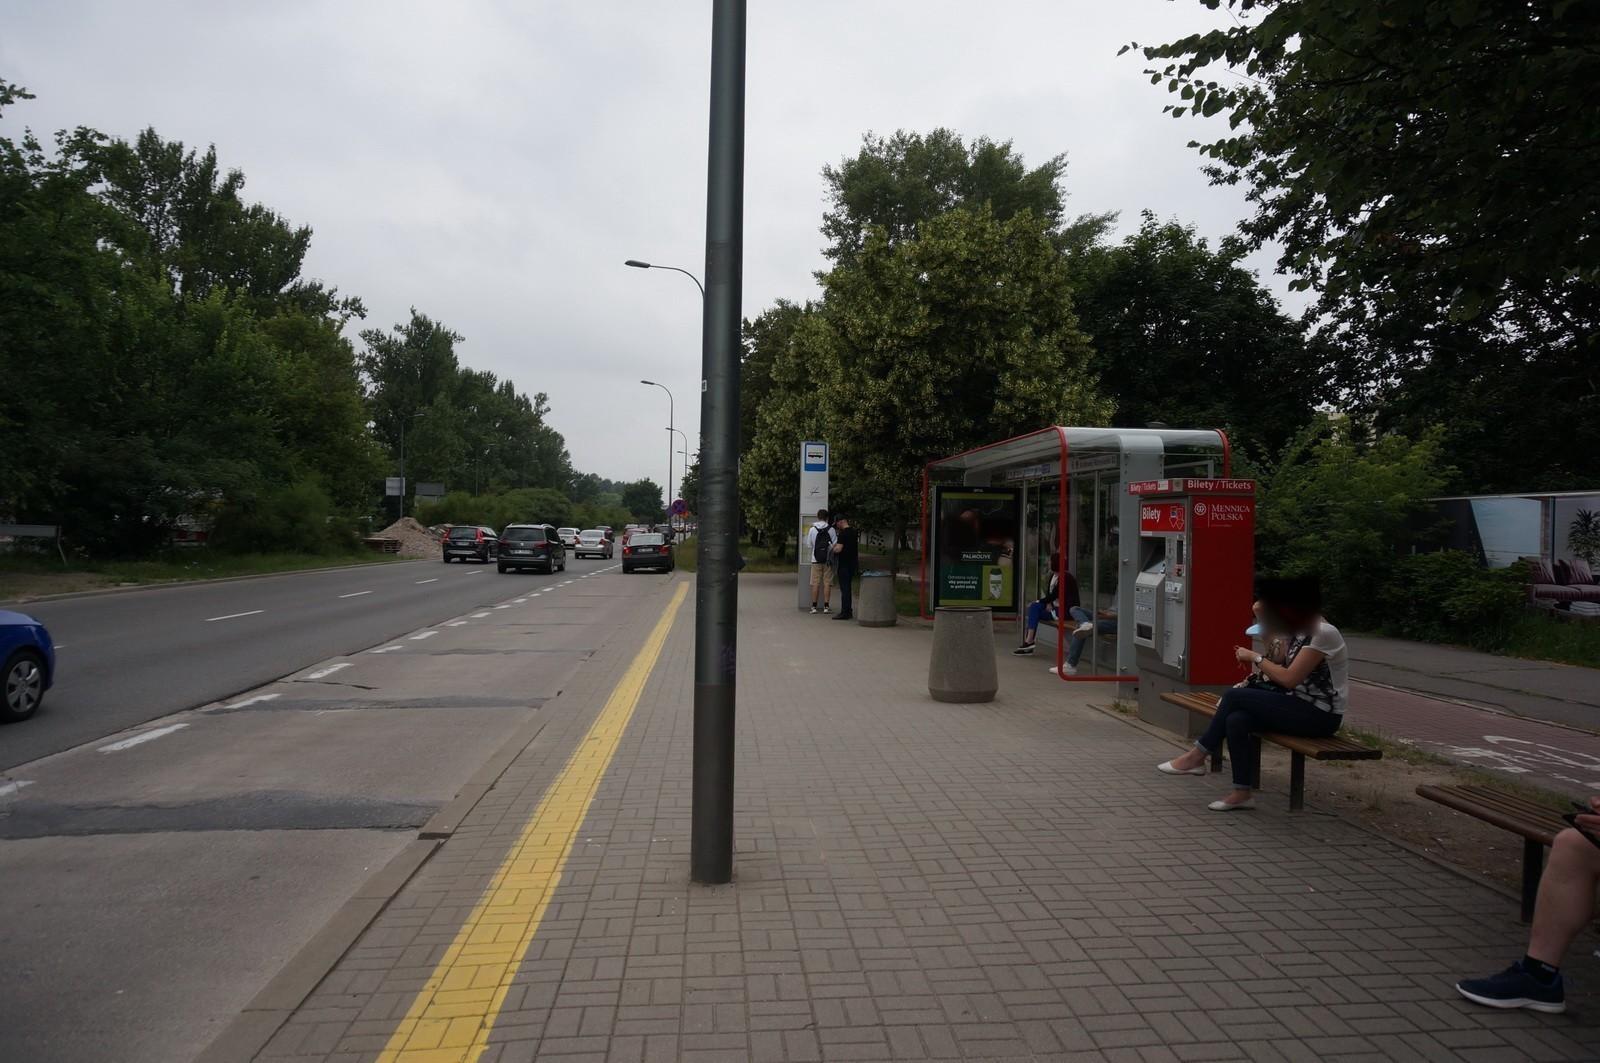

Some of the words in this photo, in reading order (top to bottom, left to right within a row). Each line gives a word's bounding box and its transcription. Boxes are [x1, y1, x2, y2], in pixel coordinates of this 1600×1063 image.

[1187, 479, 1214, 491] Bilety
[1221, 480, 1252, 490] Tickets
[1142, 506, 1161, 523] Bilety
